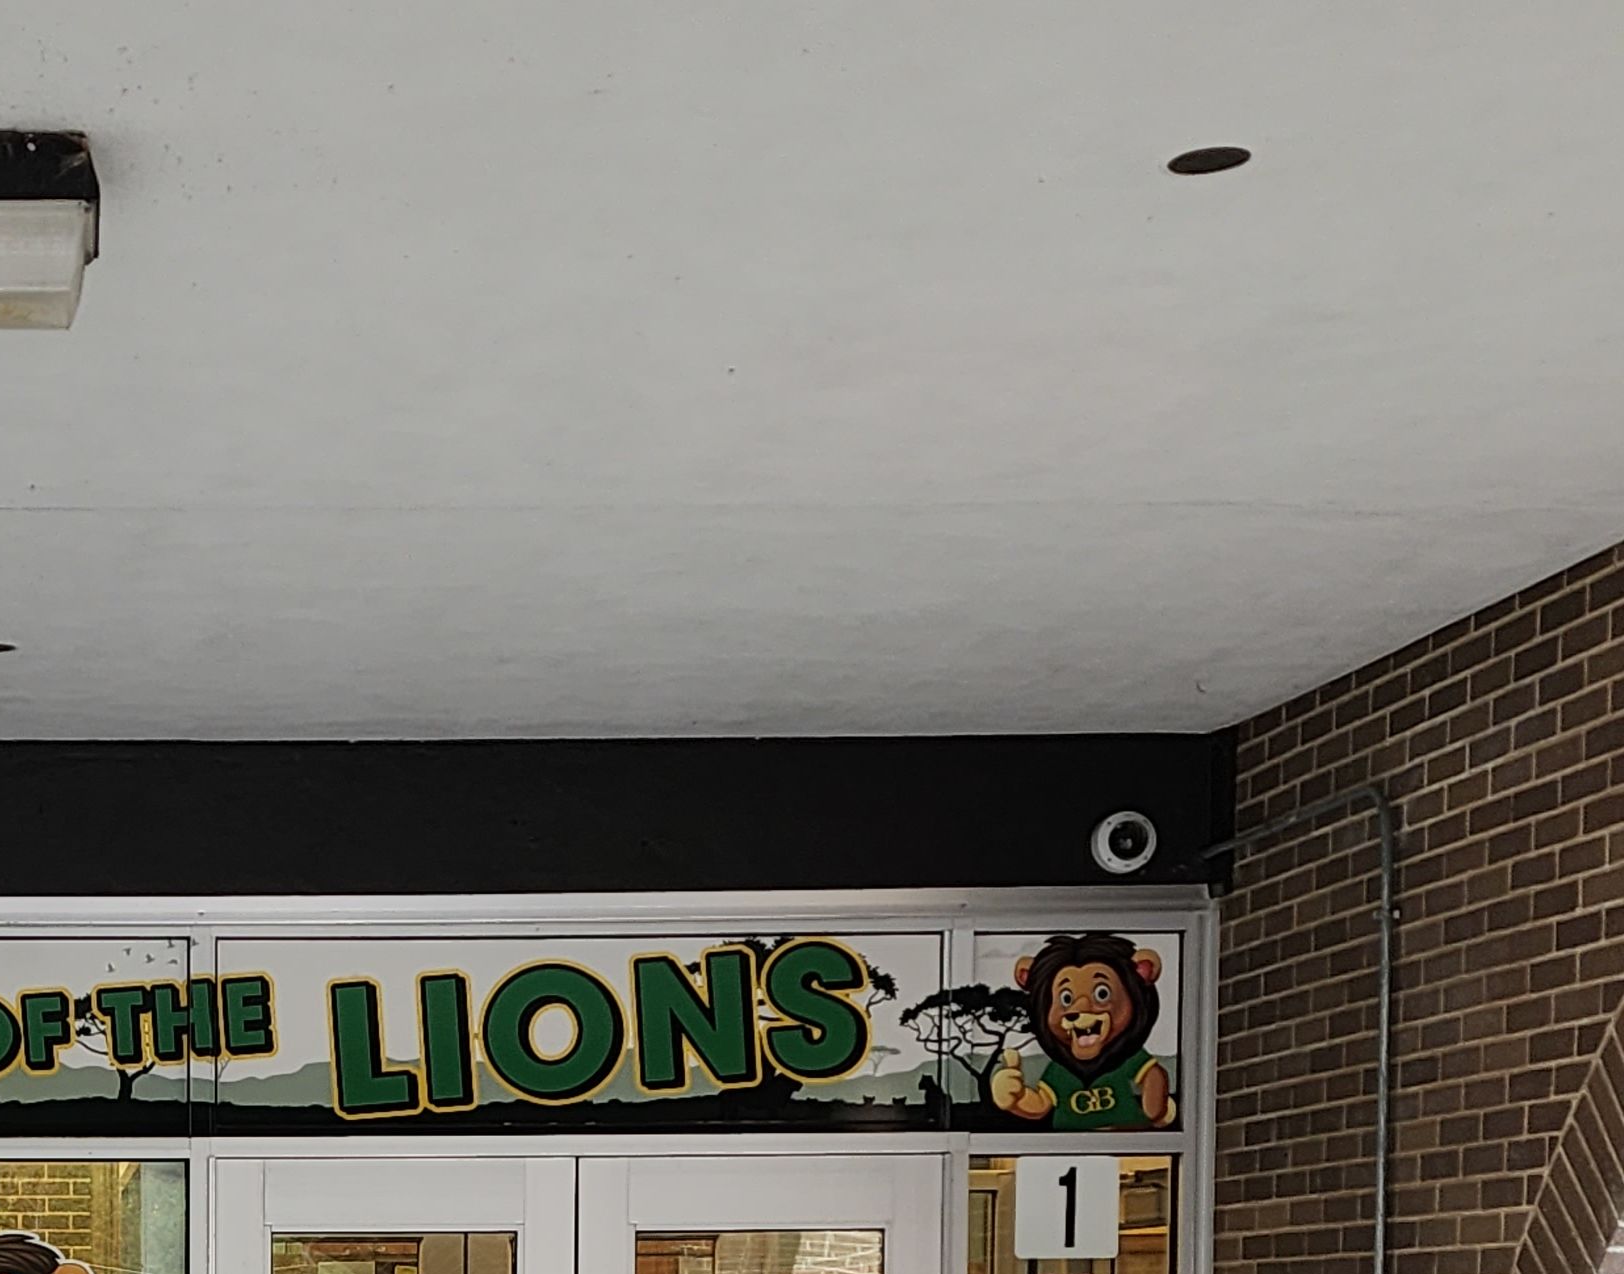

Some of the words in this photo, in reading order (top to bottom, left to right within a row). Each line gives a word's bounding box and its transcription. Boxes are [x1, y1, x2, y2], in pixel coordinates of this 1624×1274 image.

[93, 972, 276, 1067] THE
[328, 938, 872, 1118] LIONS
[1070, 1086, 1115, 1114] GB
[1059, 1167, 1077, 1247] 1
